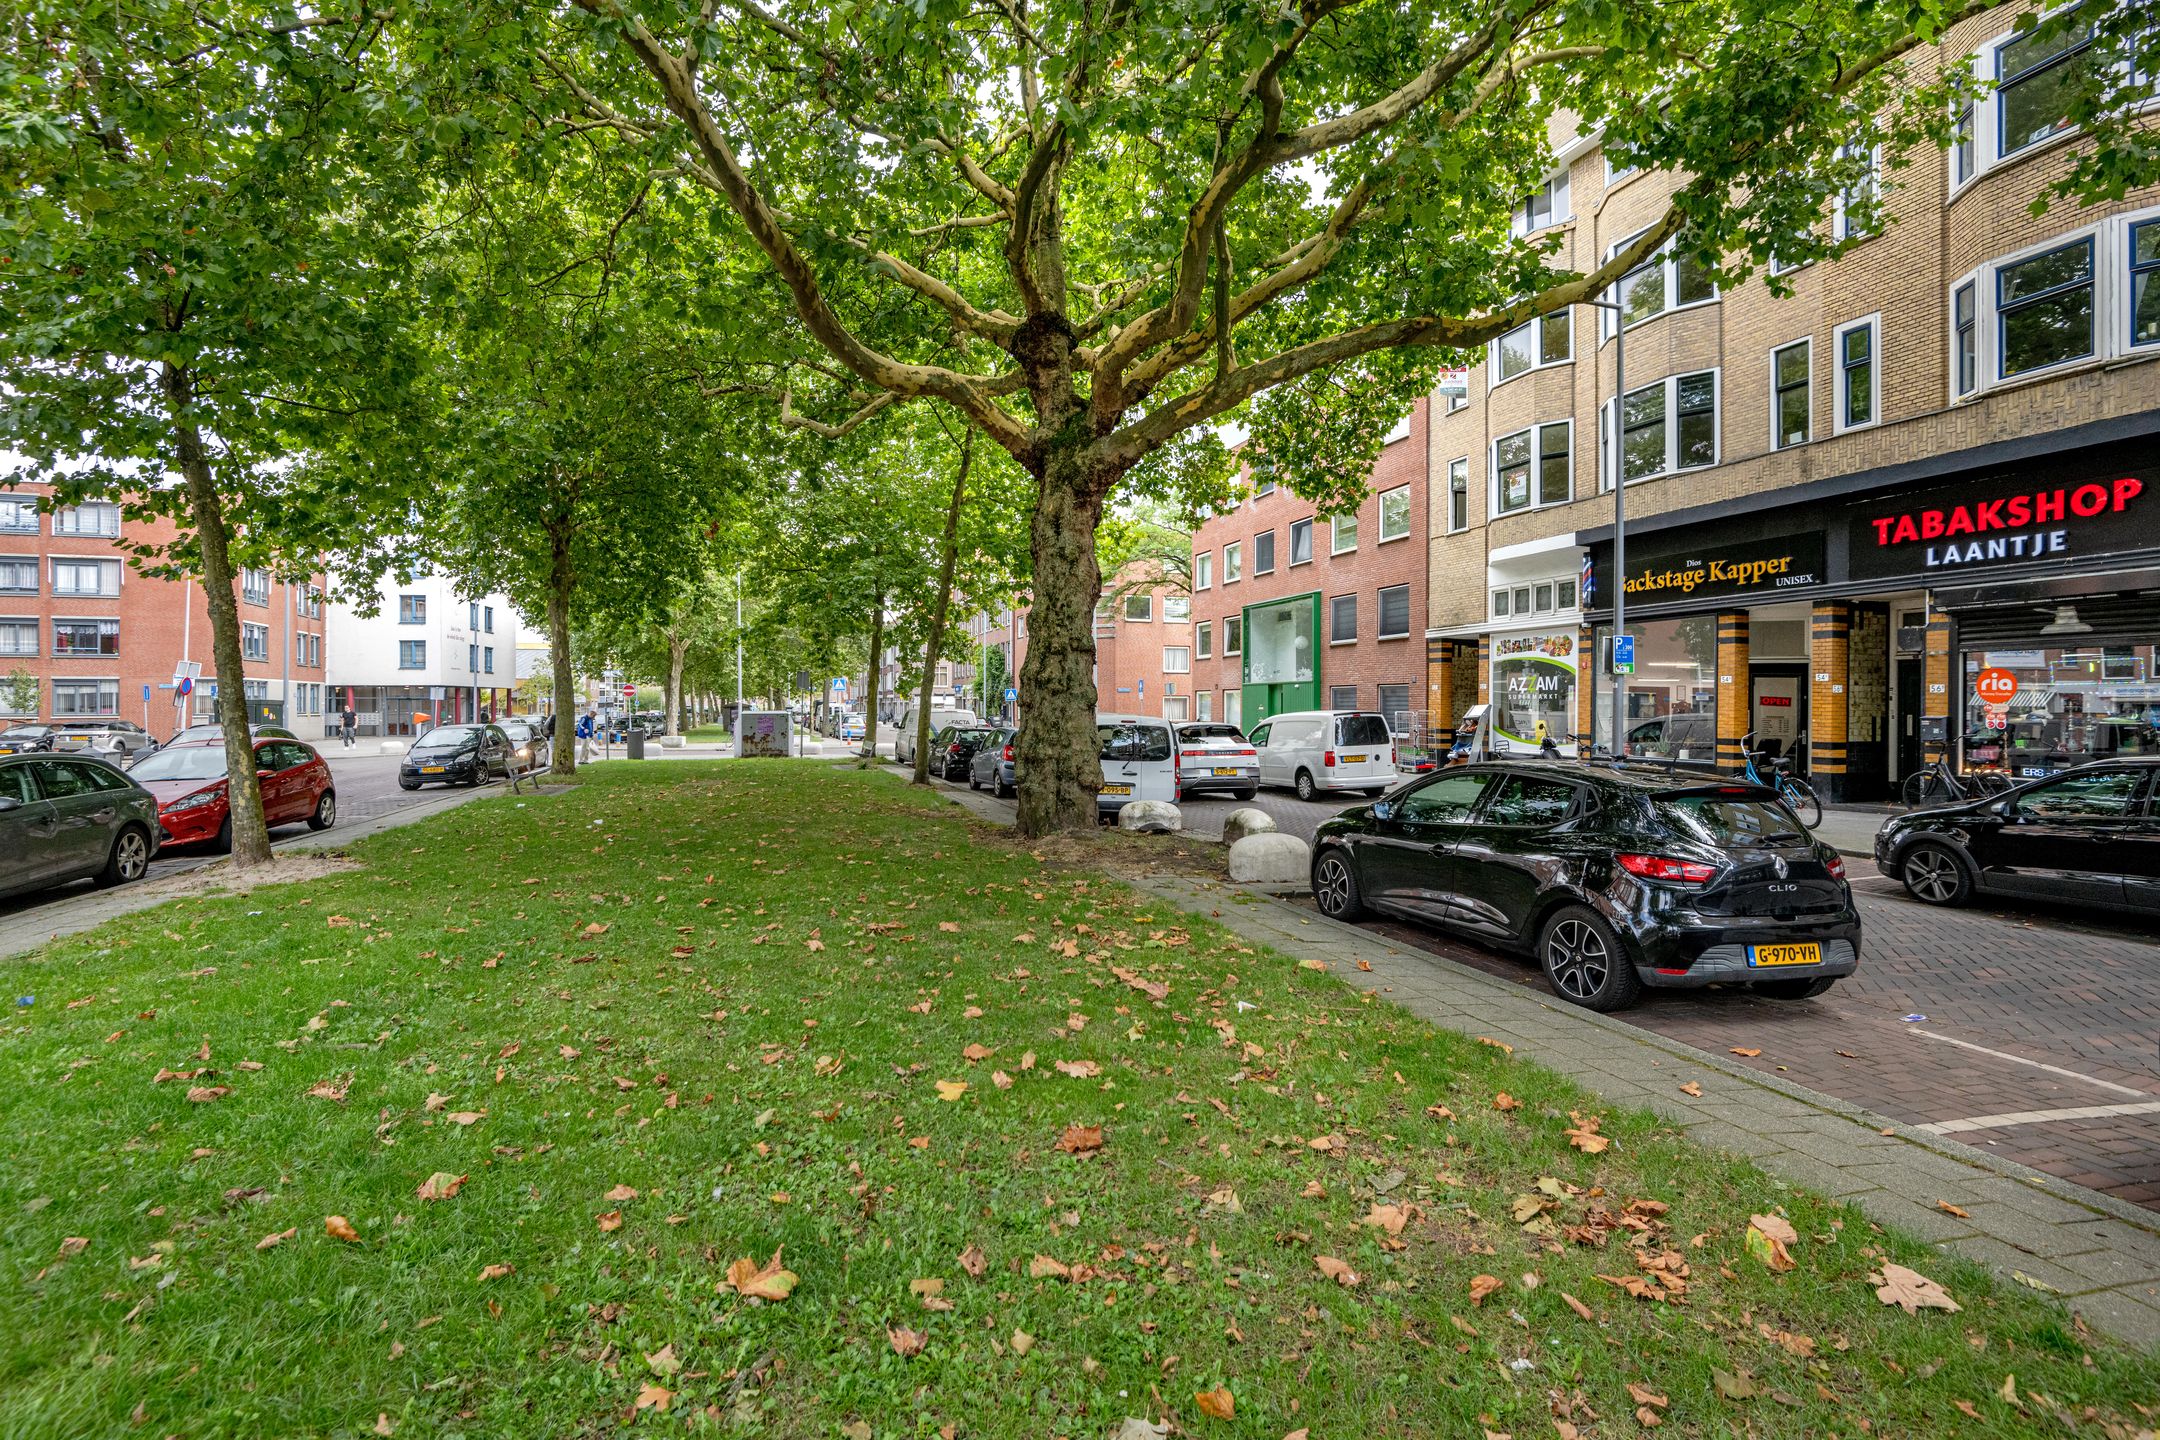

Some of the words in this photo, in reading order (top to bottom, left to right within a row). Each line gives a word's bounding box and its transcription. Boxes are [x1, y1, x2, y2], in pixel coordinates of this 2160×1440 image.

[1872, 478, 2143, 546] TABAKSHOP
[1926, 529, 2068, 567] LAANTJE
[1686, 559, 1702, 568] Dios
[1708, 555, 1793, 586] Kapper
[1775, 573, 1814, 587] UNISEX
[1615, 637, 1623, 650] P
[1508, 675, 1558, 693] AZZAM
[1981, 672, 2013, 691] ria
[1762, 697, 1790, 705] OPEN
[1768, 884, 1798, 892] CLIO
[1759, 945, 1817, 963] G-970-VH
